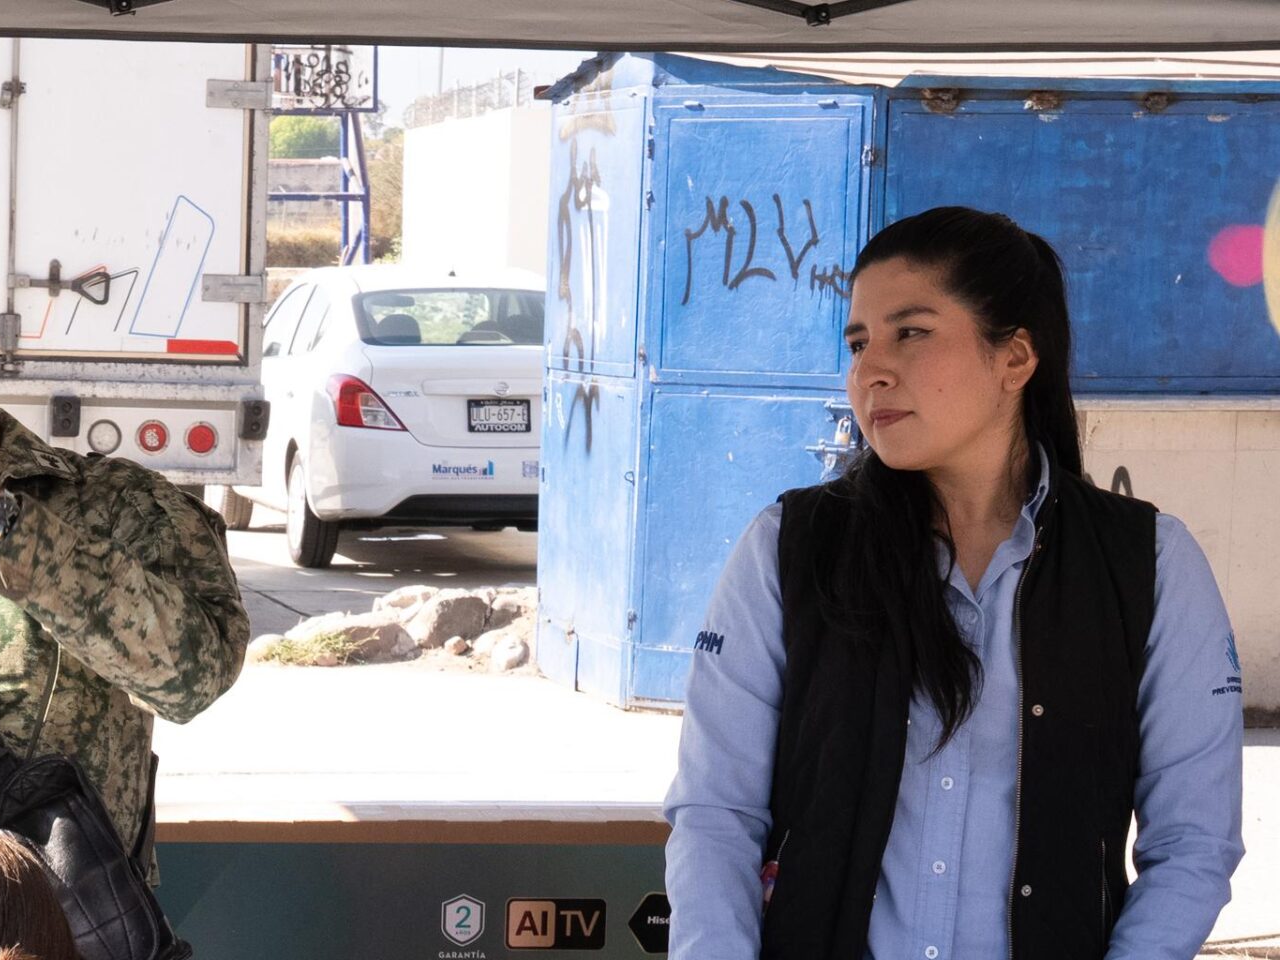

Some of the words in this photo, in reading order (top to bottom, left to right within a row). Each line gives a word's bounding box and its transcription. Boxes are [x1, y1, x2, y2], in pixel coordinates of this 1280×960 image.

[474, 423, 527, 432] AUTOCOM
[432, 463, 478, 475] Marqués
[455, 905, 471, 929] 2
[515, 910, 549, 937] AI
[559, 910, 601, 937] TV
[438, 950, 487, 960] GARANTÍA
